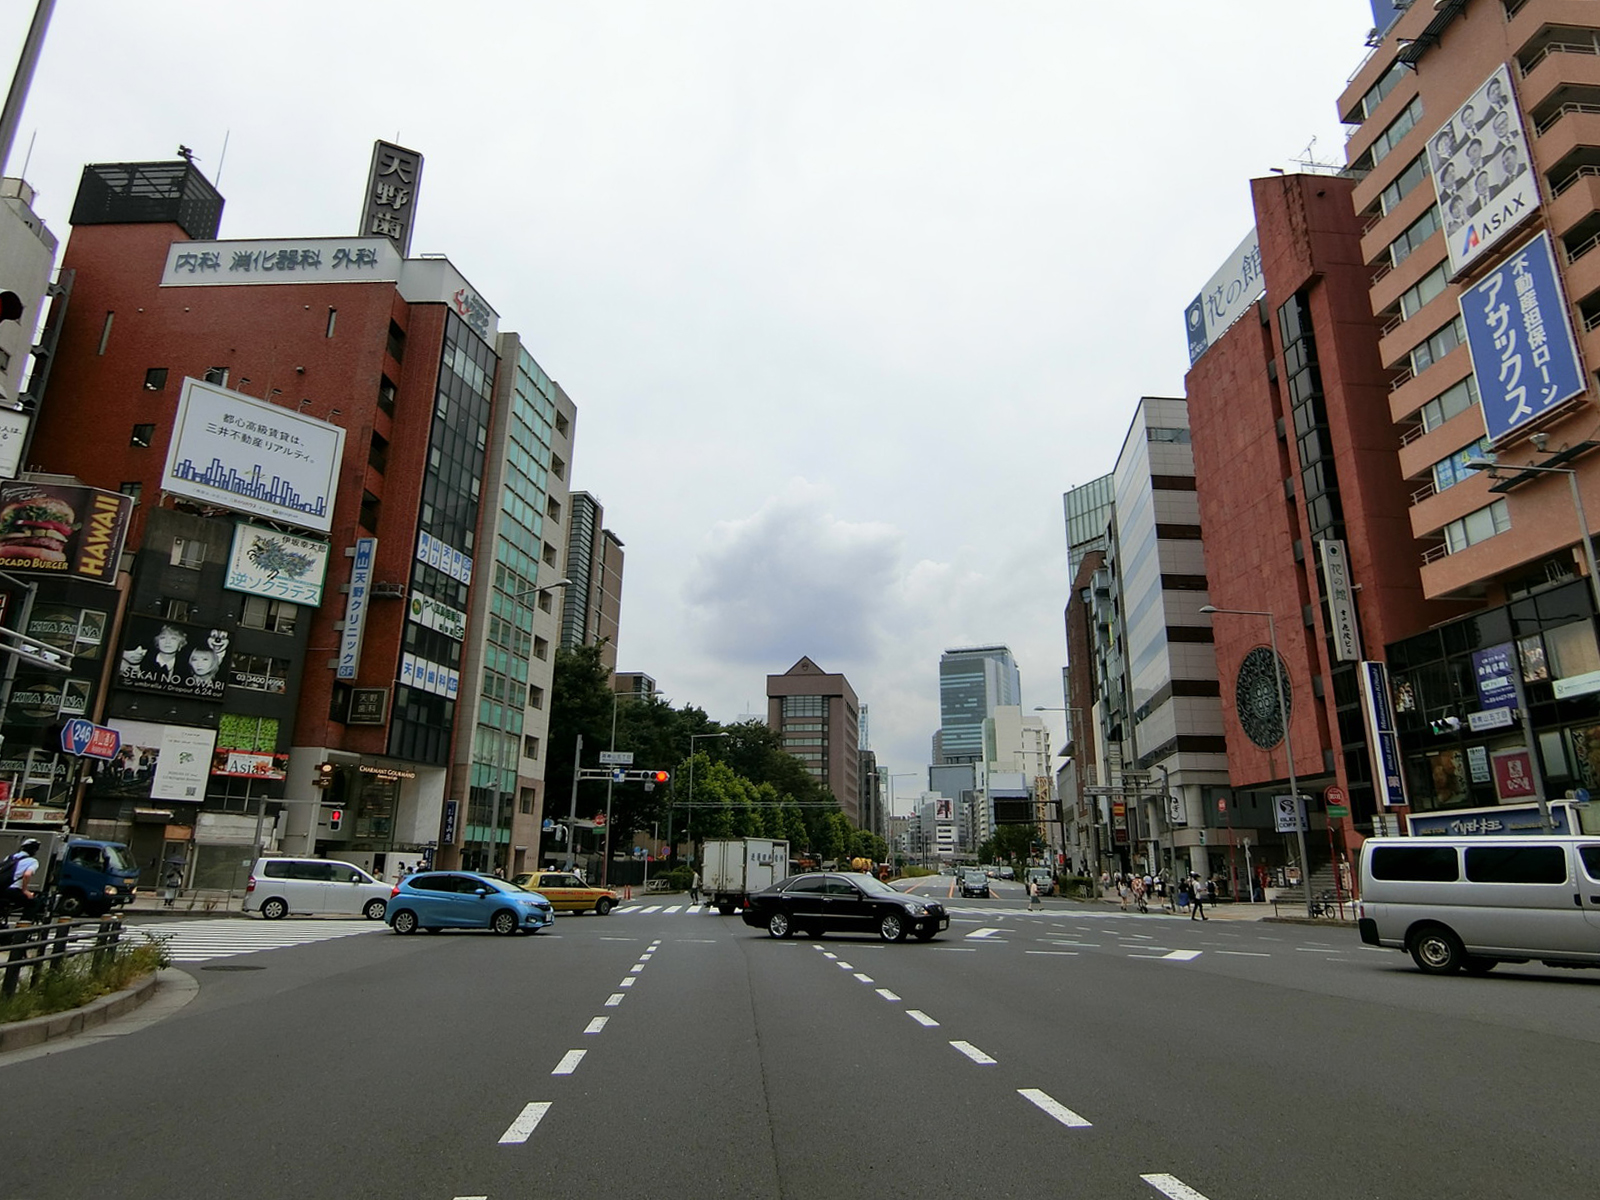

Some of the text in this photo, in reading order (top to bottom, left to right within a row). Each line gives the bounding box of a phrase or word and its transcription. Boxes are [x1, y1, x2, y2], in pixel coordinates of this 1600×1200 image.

[372, 153, 412, 240] 天野歯
[174, 248, 378, 273] 内科 消化器科 外科
[1205, 245, 1263, 327] 花の館
[1510, 253, 1558, 405] 不動産担保ローン
[1478, 272, 1533, 425] アサックス
[0, 425, 22, 435] 人は、
[206, 422, 314, 463] 三井不動産リアルティ。
[223, 413, 305, 446] 都心高級賃貸は、
[79, 495, 121, 576] HAWAII
[282, 535, 327, 553] 伊坂幸太郎
[421, 533, 461, 565] 青山天野
[419, 549, 469, 582] クリニック
[229, 571, 318, 603] 逆ソクラテス
[341, 540, 372, 665] 青山天野クリニック
[123, 666, 157, 681] SEKAI
[161, 670, 181, 685] NO
[185, 675, 225, 691] OWARI
[134, 681, 162, 690] umbrella
[339, 666, 354, 677] 6F
[403, 662, 446, 688] 天野歯科
[74, 725, 91, 743] 246
[228, 759, 268, 777] Asias
